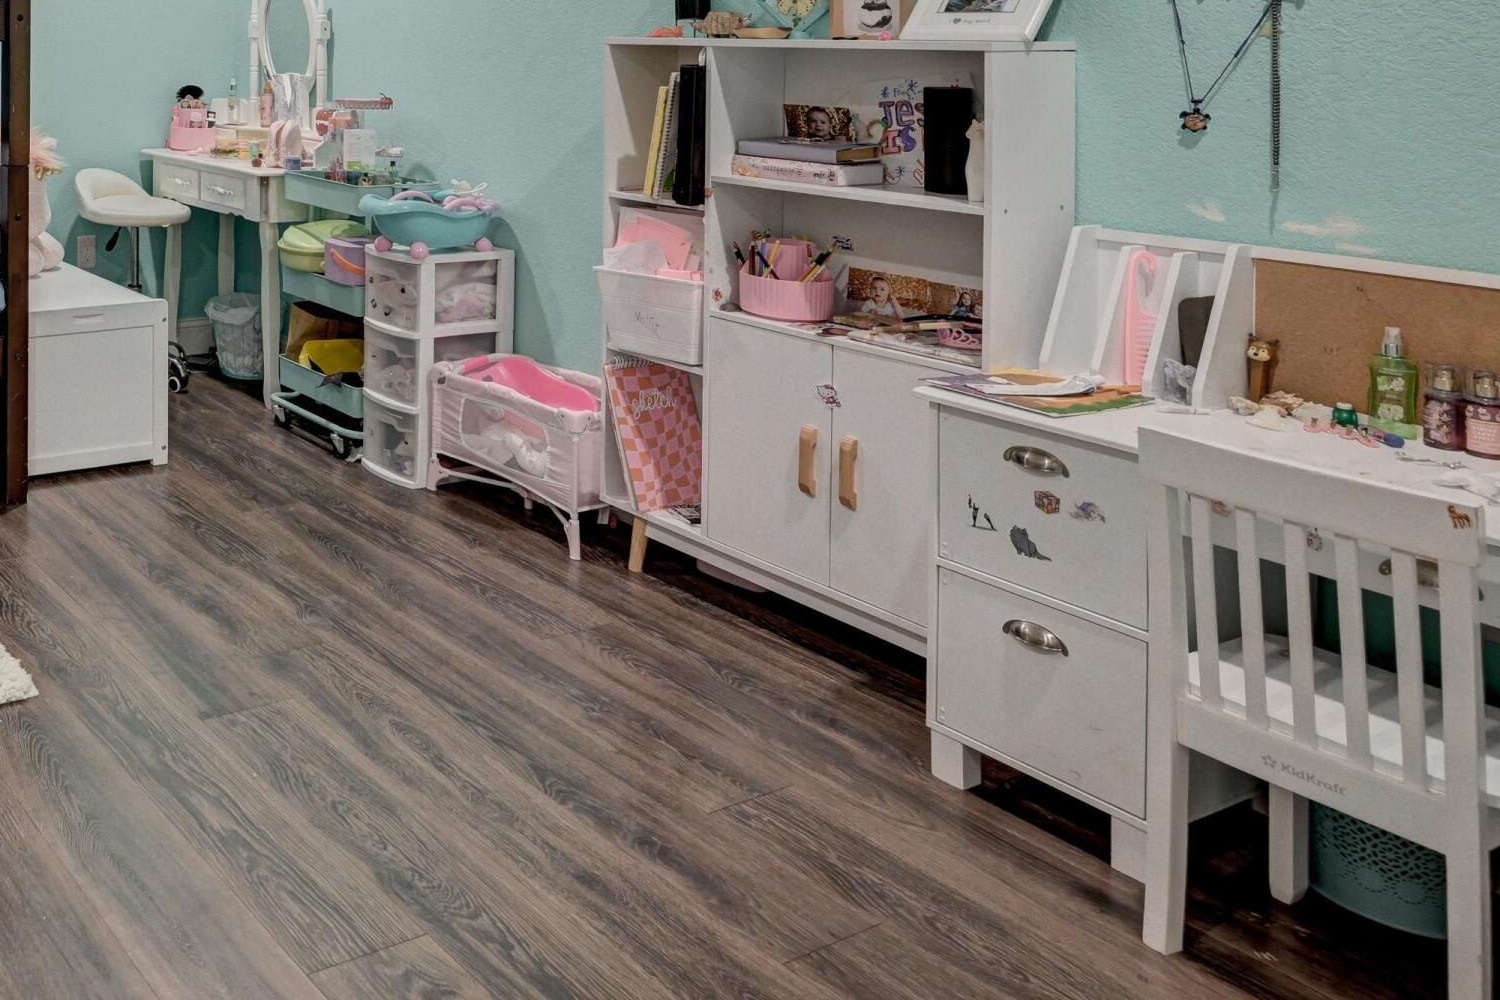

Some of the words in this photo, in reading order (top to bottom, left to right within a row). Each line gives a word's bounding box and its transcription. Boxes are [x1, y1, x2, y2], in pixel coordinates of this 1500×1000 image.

[882, 126, 917, 155] IS
[632, 385, 677, 419] sketch
[1281, 762, 1347, 796] KidKraft
